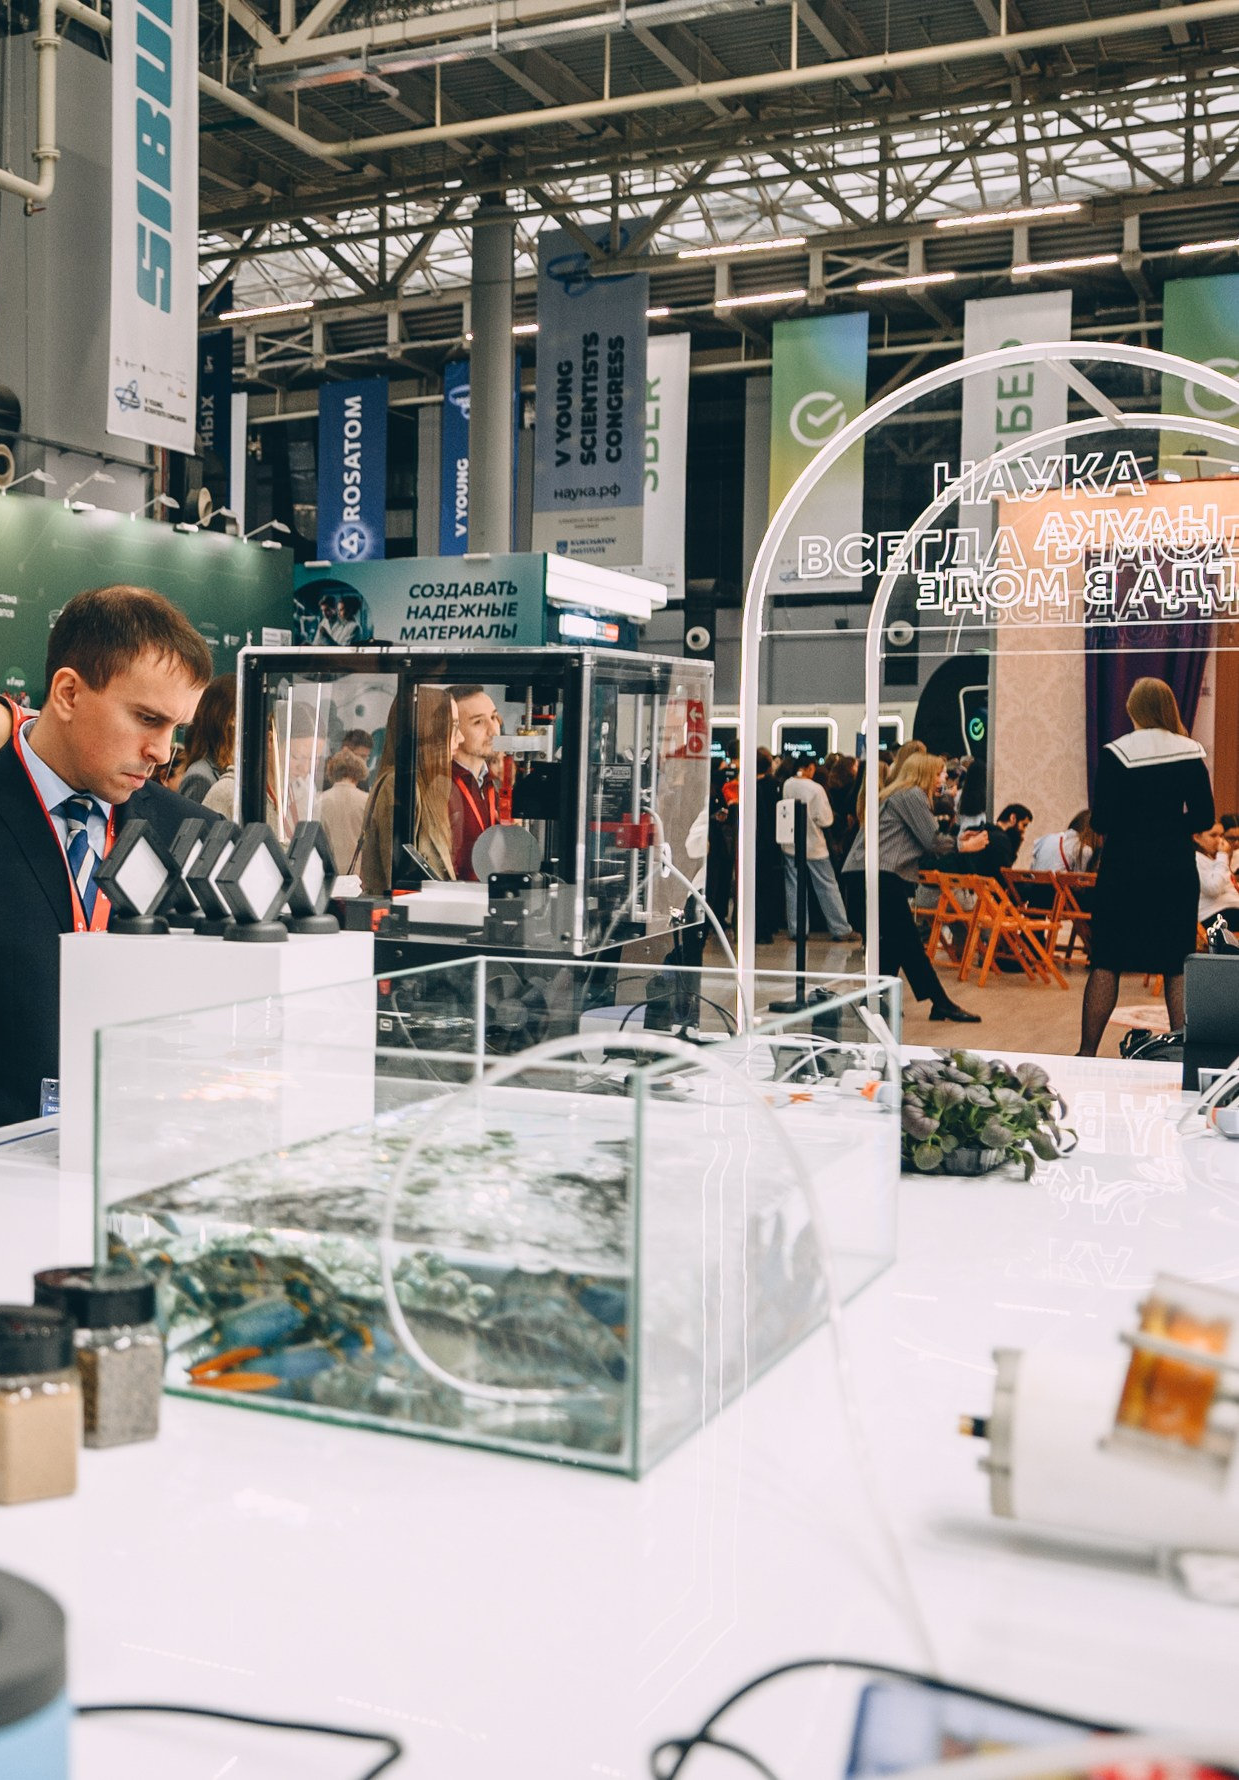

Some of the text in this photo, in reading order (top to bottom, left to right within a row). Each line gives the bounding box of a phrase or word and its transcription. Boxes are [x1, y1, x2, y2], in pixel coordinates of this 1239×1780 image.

[136, 0, 173, 314] SIBU
[556, 360, 573, 467] V YOUNG
[580, 331, 599, 466] SCIENTISTS
[606, 335, 625, 463] CONGRESS
[342, 395, 362, 522] ROSATOM
[554, 482, 621, 501] наука.рф
[934, 450, 1148, 506] НАУКА
[455, 458, 469, 537] V YOUNG
[798, 526, 1027, 580] ВСЕГДА
[406, 602, 518, 621] НАДЕЖНЫЕ
[409, 580, 518, 600] СОЗДАВАТЬ
[399, 623, 518, 641] МАТЕРИАЛЫ
